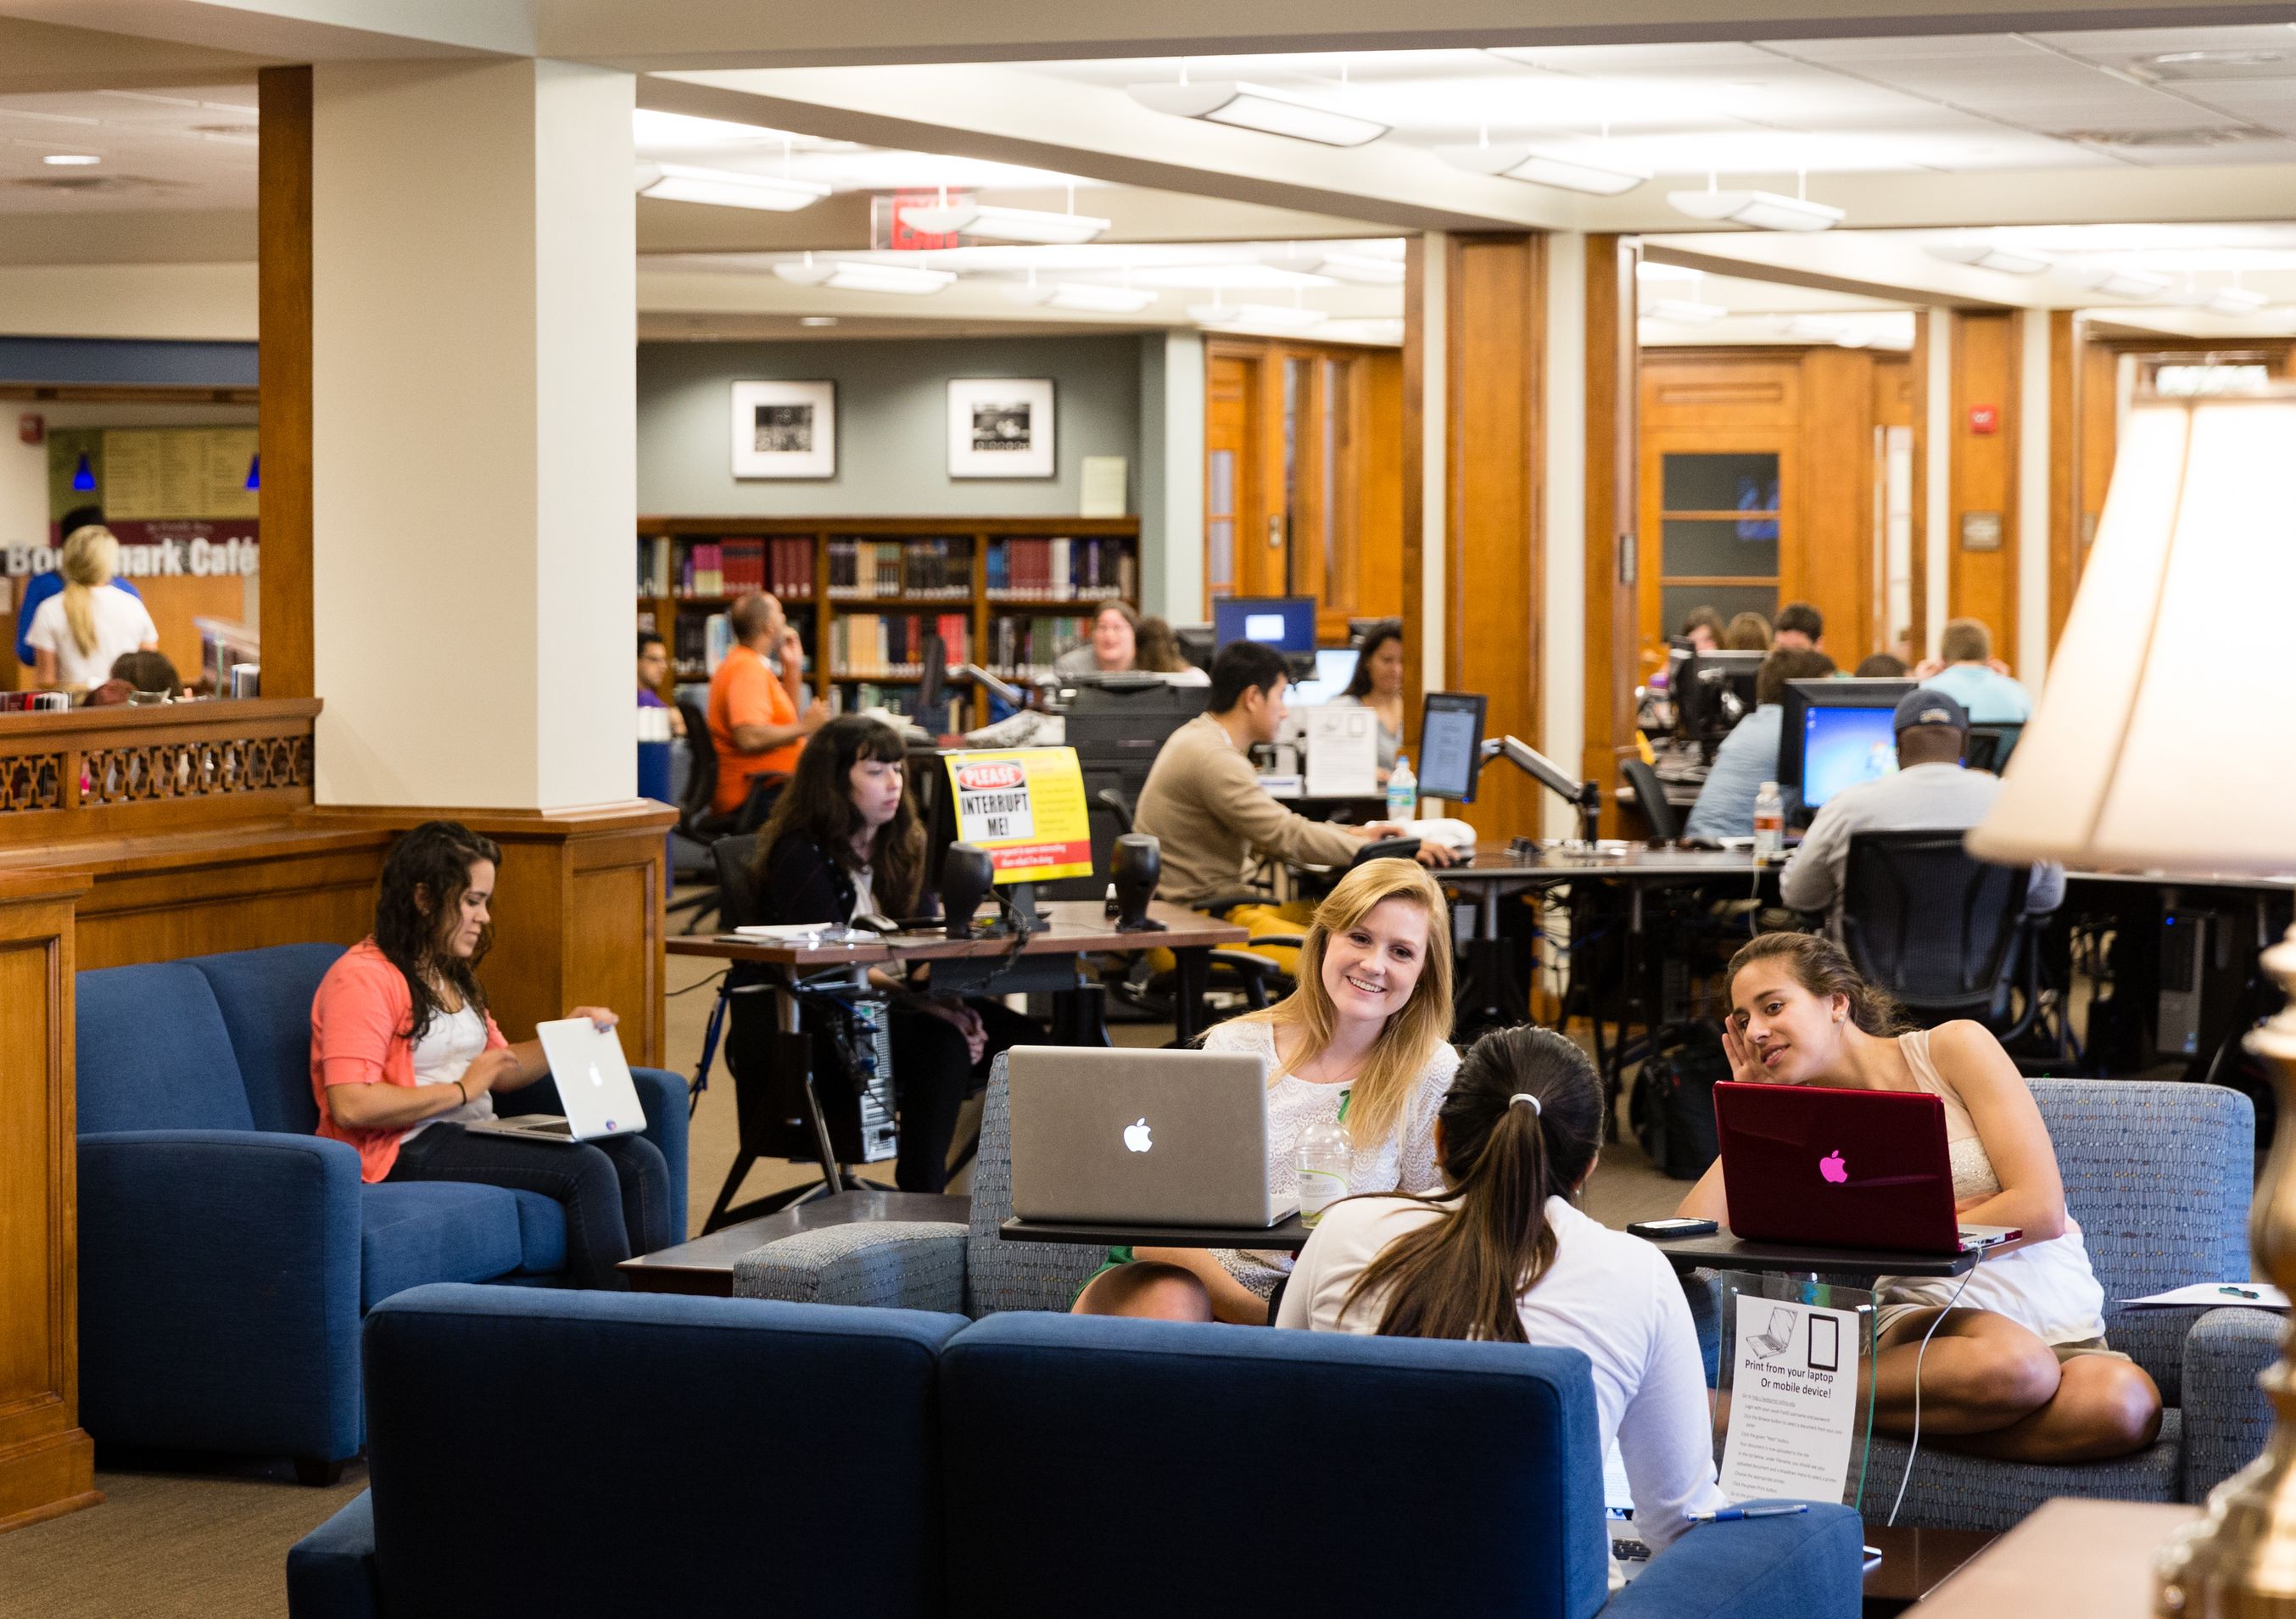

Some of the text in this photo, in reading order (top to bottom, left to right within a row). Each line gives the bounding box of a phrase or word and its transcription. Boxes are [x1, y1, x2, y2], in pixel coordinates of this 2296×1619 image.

[8, 535, 255, 577] Bomark Café
[964, 766, 1016, 786] PLEASE
[961, 793, 1028, 815] INTERRUPT
[987, 817, 1009, 836] ME!
[1745, 1359, 1834, 1384] Print from your laptop
[1761, 1377, 1831, 1398] Or mobile device!
